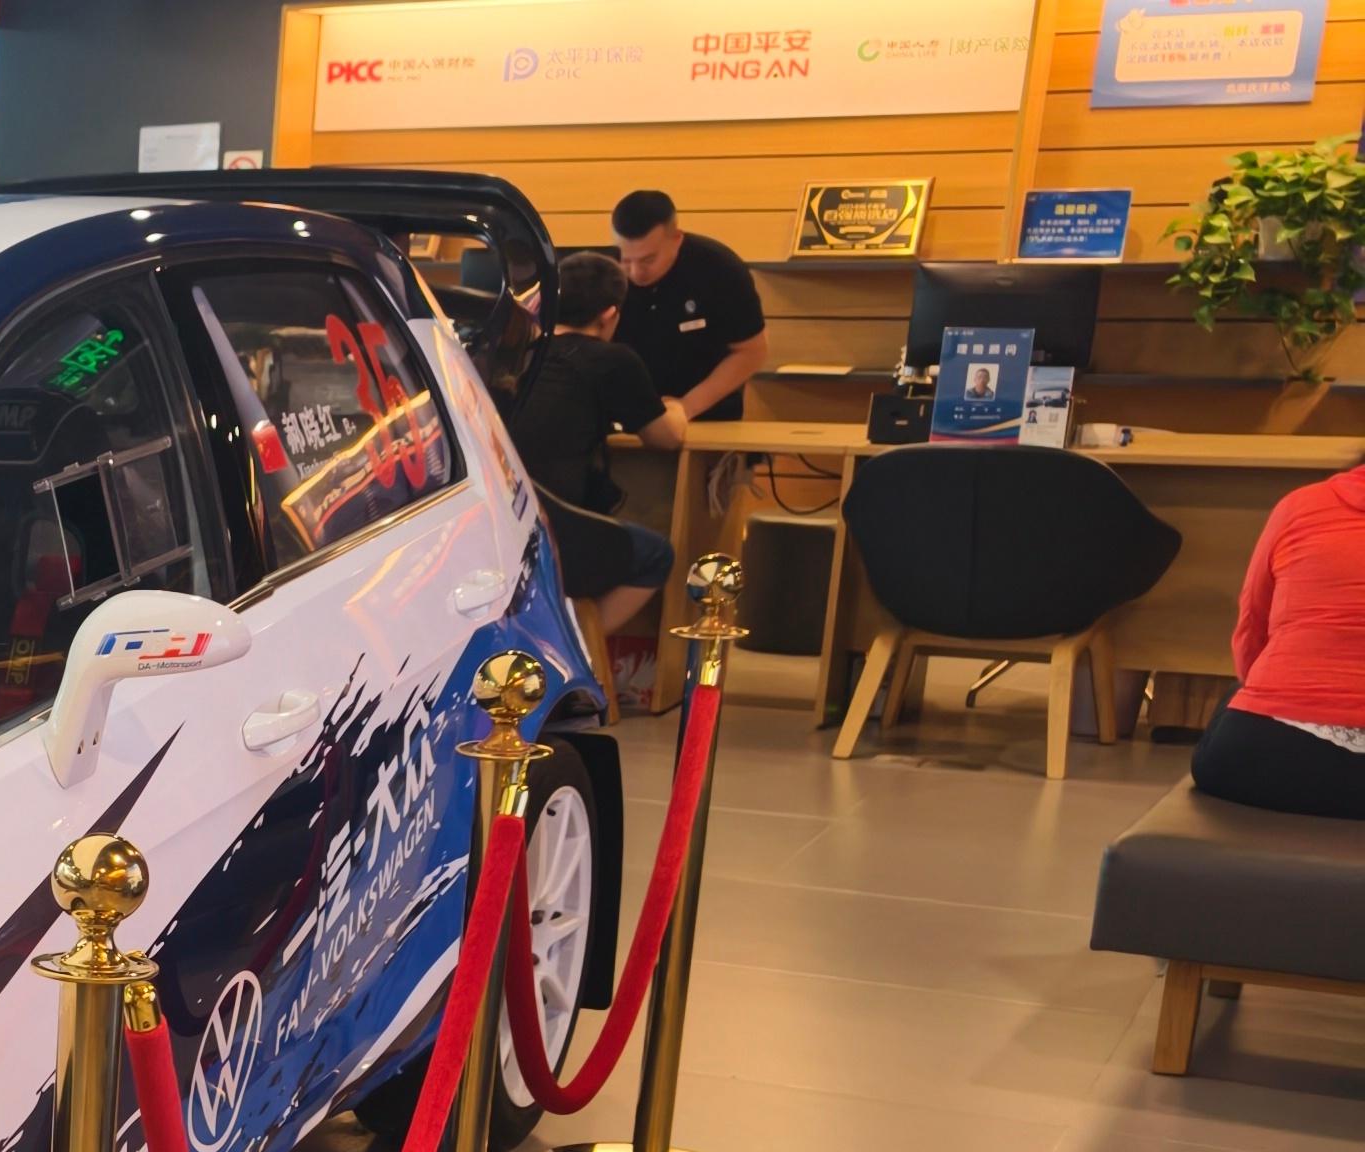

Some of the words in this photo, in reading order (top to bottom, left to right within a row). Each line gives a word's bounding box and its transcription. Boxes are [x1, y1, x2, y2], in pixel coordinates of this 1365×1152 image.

[692, 29, 812, 56] 中国平安
[326, 60, 384, 84] PICC
